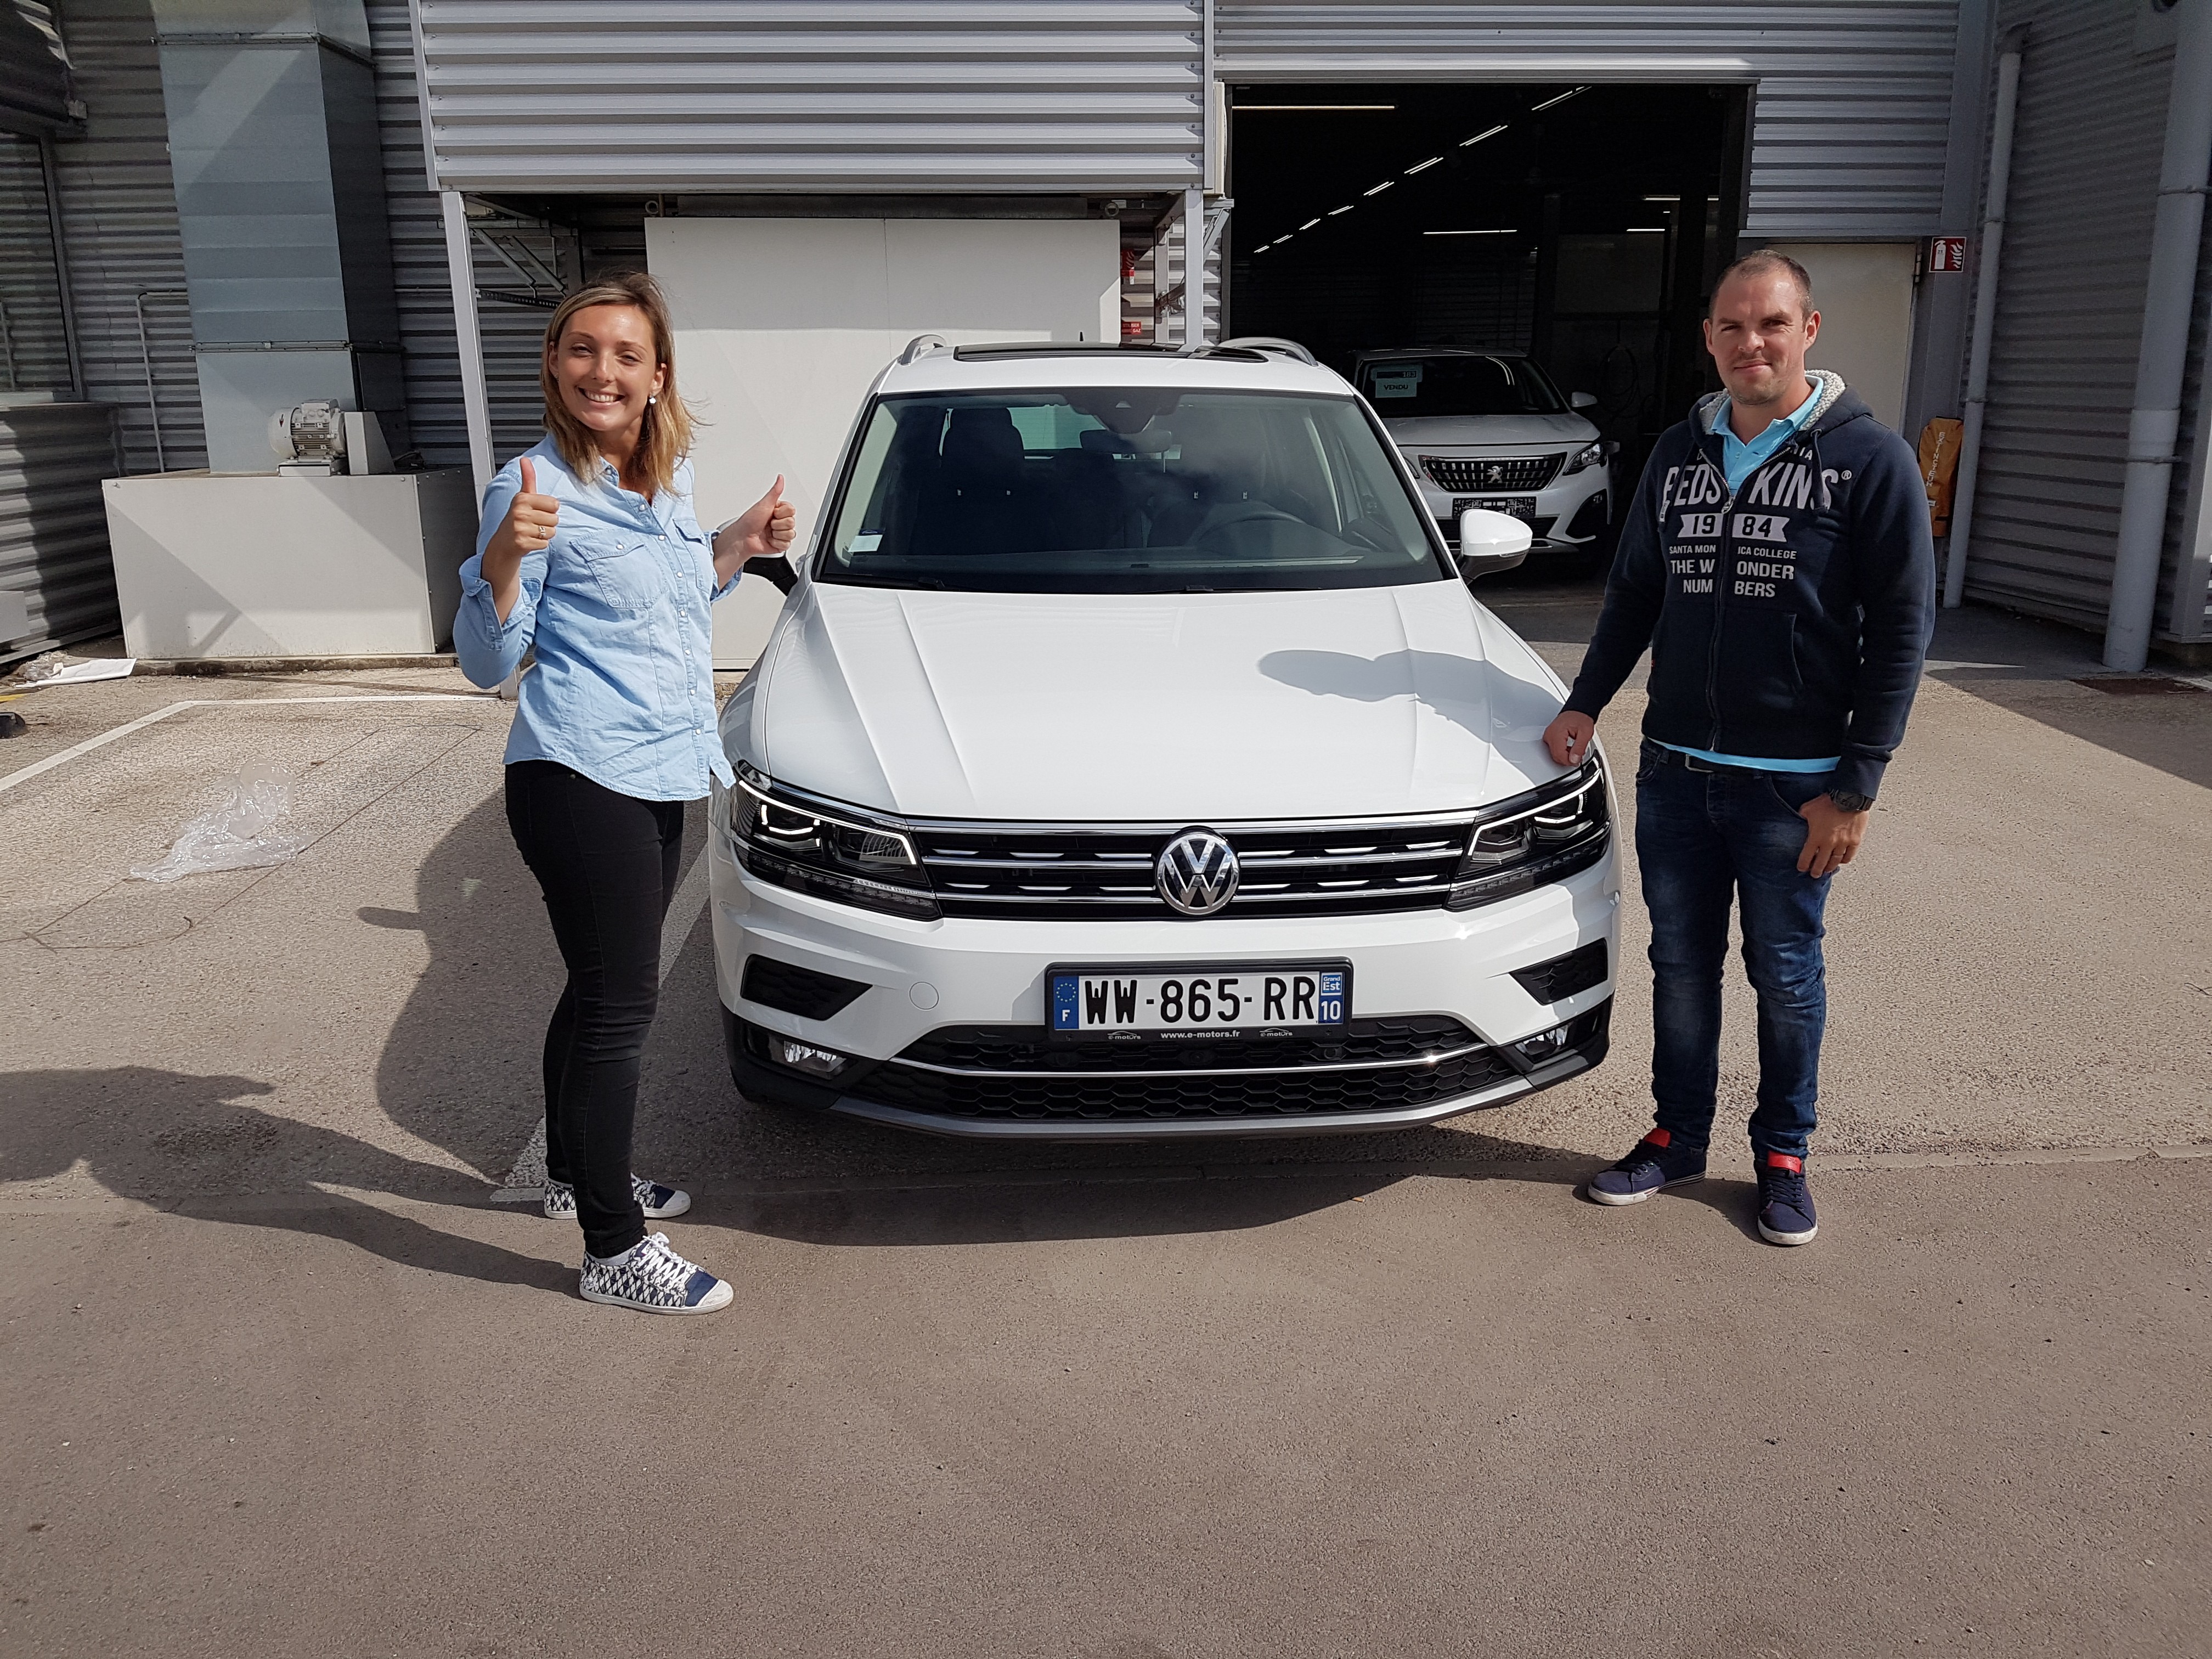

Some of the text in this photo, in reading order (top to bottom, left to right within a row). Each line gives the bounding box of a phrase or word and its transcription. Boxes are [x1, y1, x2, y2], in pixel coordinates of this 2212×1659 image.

[1669, 545, 1797, 560] SANTA MON ICA COLLEGE
[1671, 559, 1795, 580] THE W ONDER
[1683, 579, 1776, 598] NUM BERS
[1323, 981, 1340, 991] Est
[1062, 1009, 1070, 1022] F
[1321, 1001, 1341, 1020] 10
[1160, 1030, 1240, 1039] www.e-motors.fr
